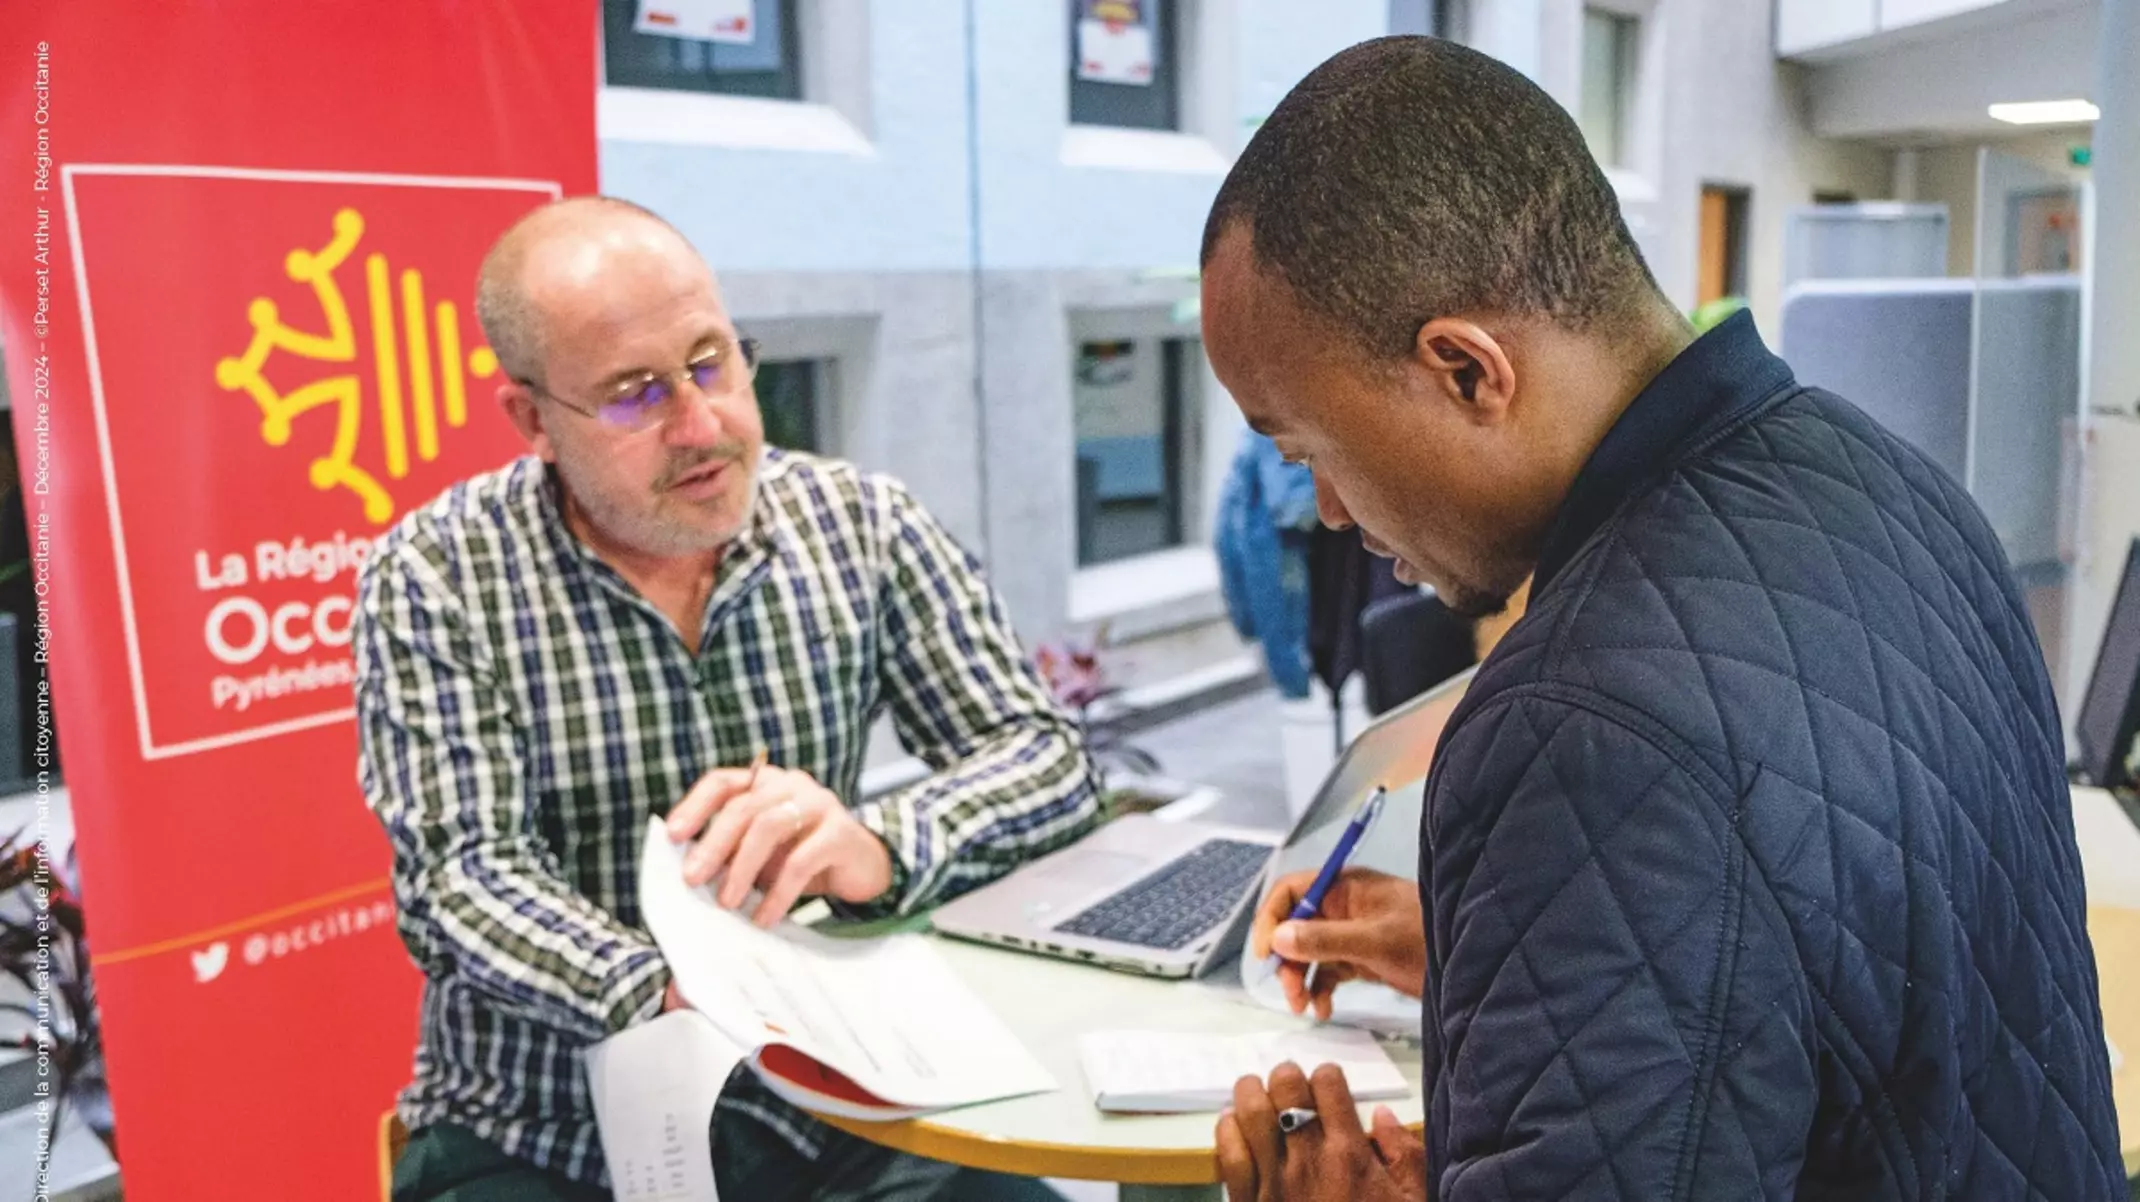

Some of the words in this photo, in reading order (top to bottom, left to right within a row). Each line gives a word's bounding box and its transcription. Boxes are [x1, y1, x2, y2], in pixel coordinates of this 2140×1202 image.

[195, 549, 248, 590] La
[254, 529, 374, 582] Régio
[204, 595, 353, 664] Occ
